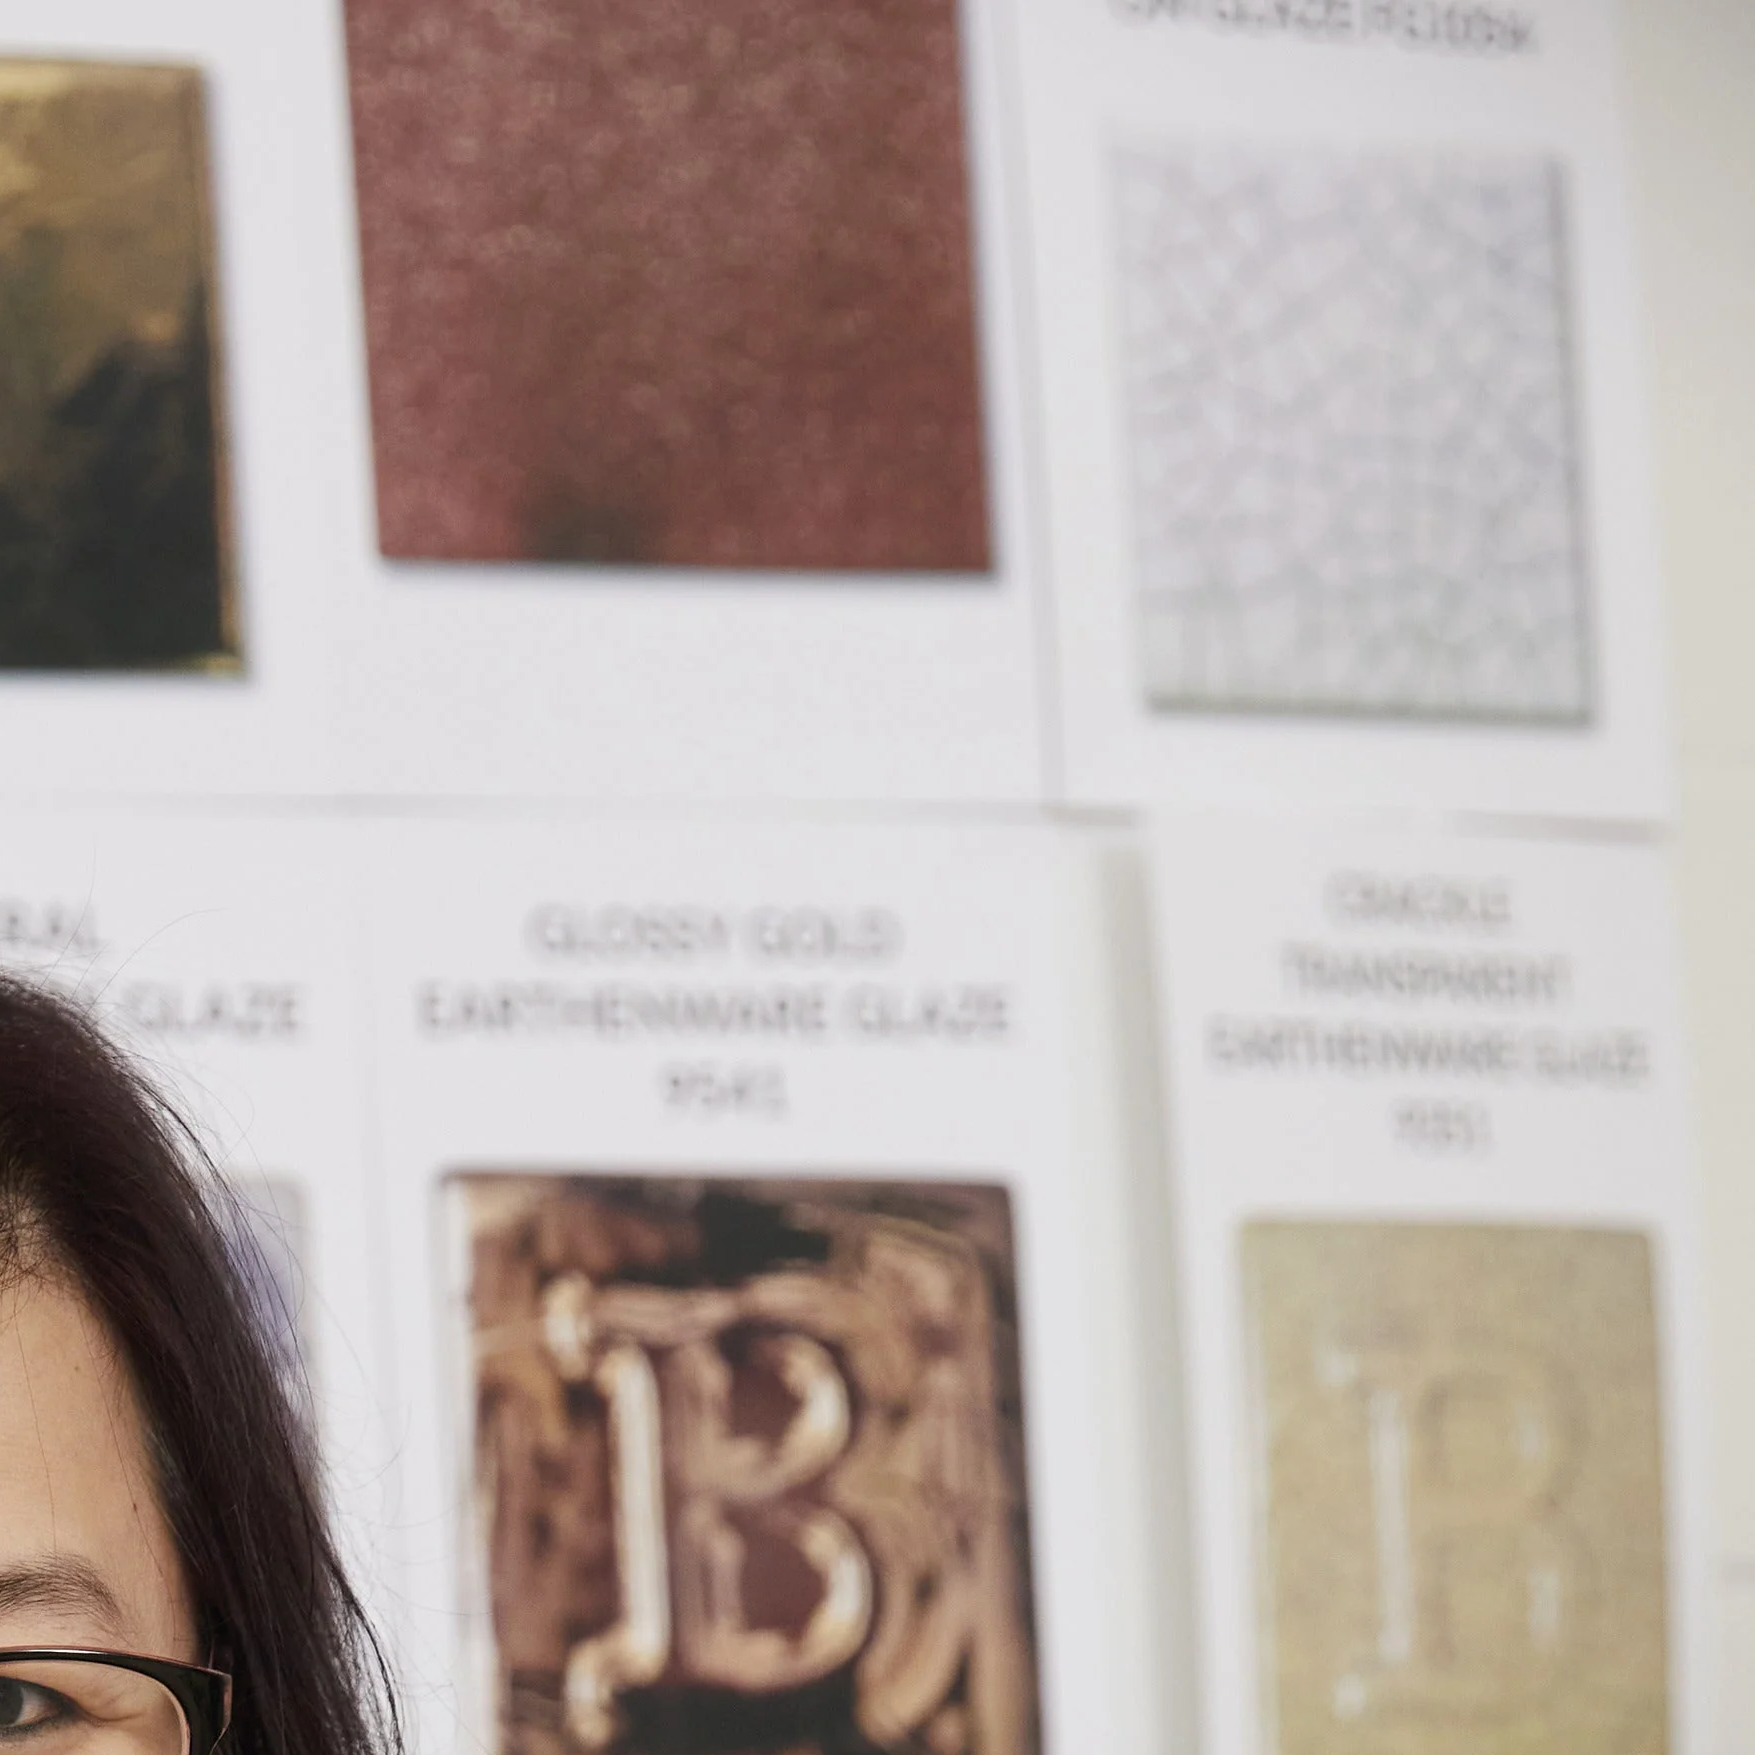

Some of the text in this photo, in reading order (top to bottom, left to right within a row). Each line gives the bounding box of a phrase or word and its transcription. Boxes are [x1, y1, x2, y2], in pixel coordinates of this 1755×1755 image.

[524, 904, 903, 968] GLOSSY GOLD
[413, 980, 1023, 1044] EARTHENWARE GLAZE
